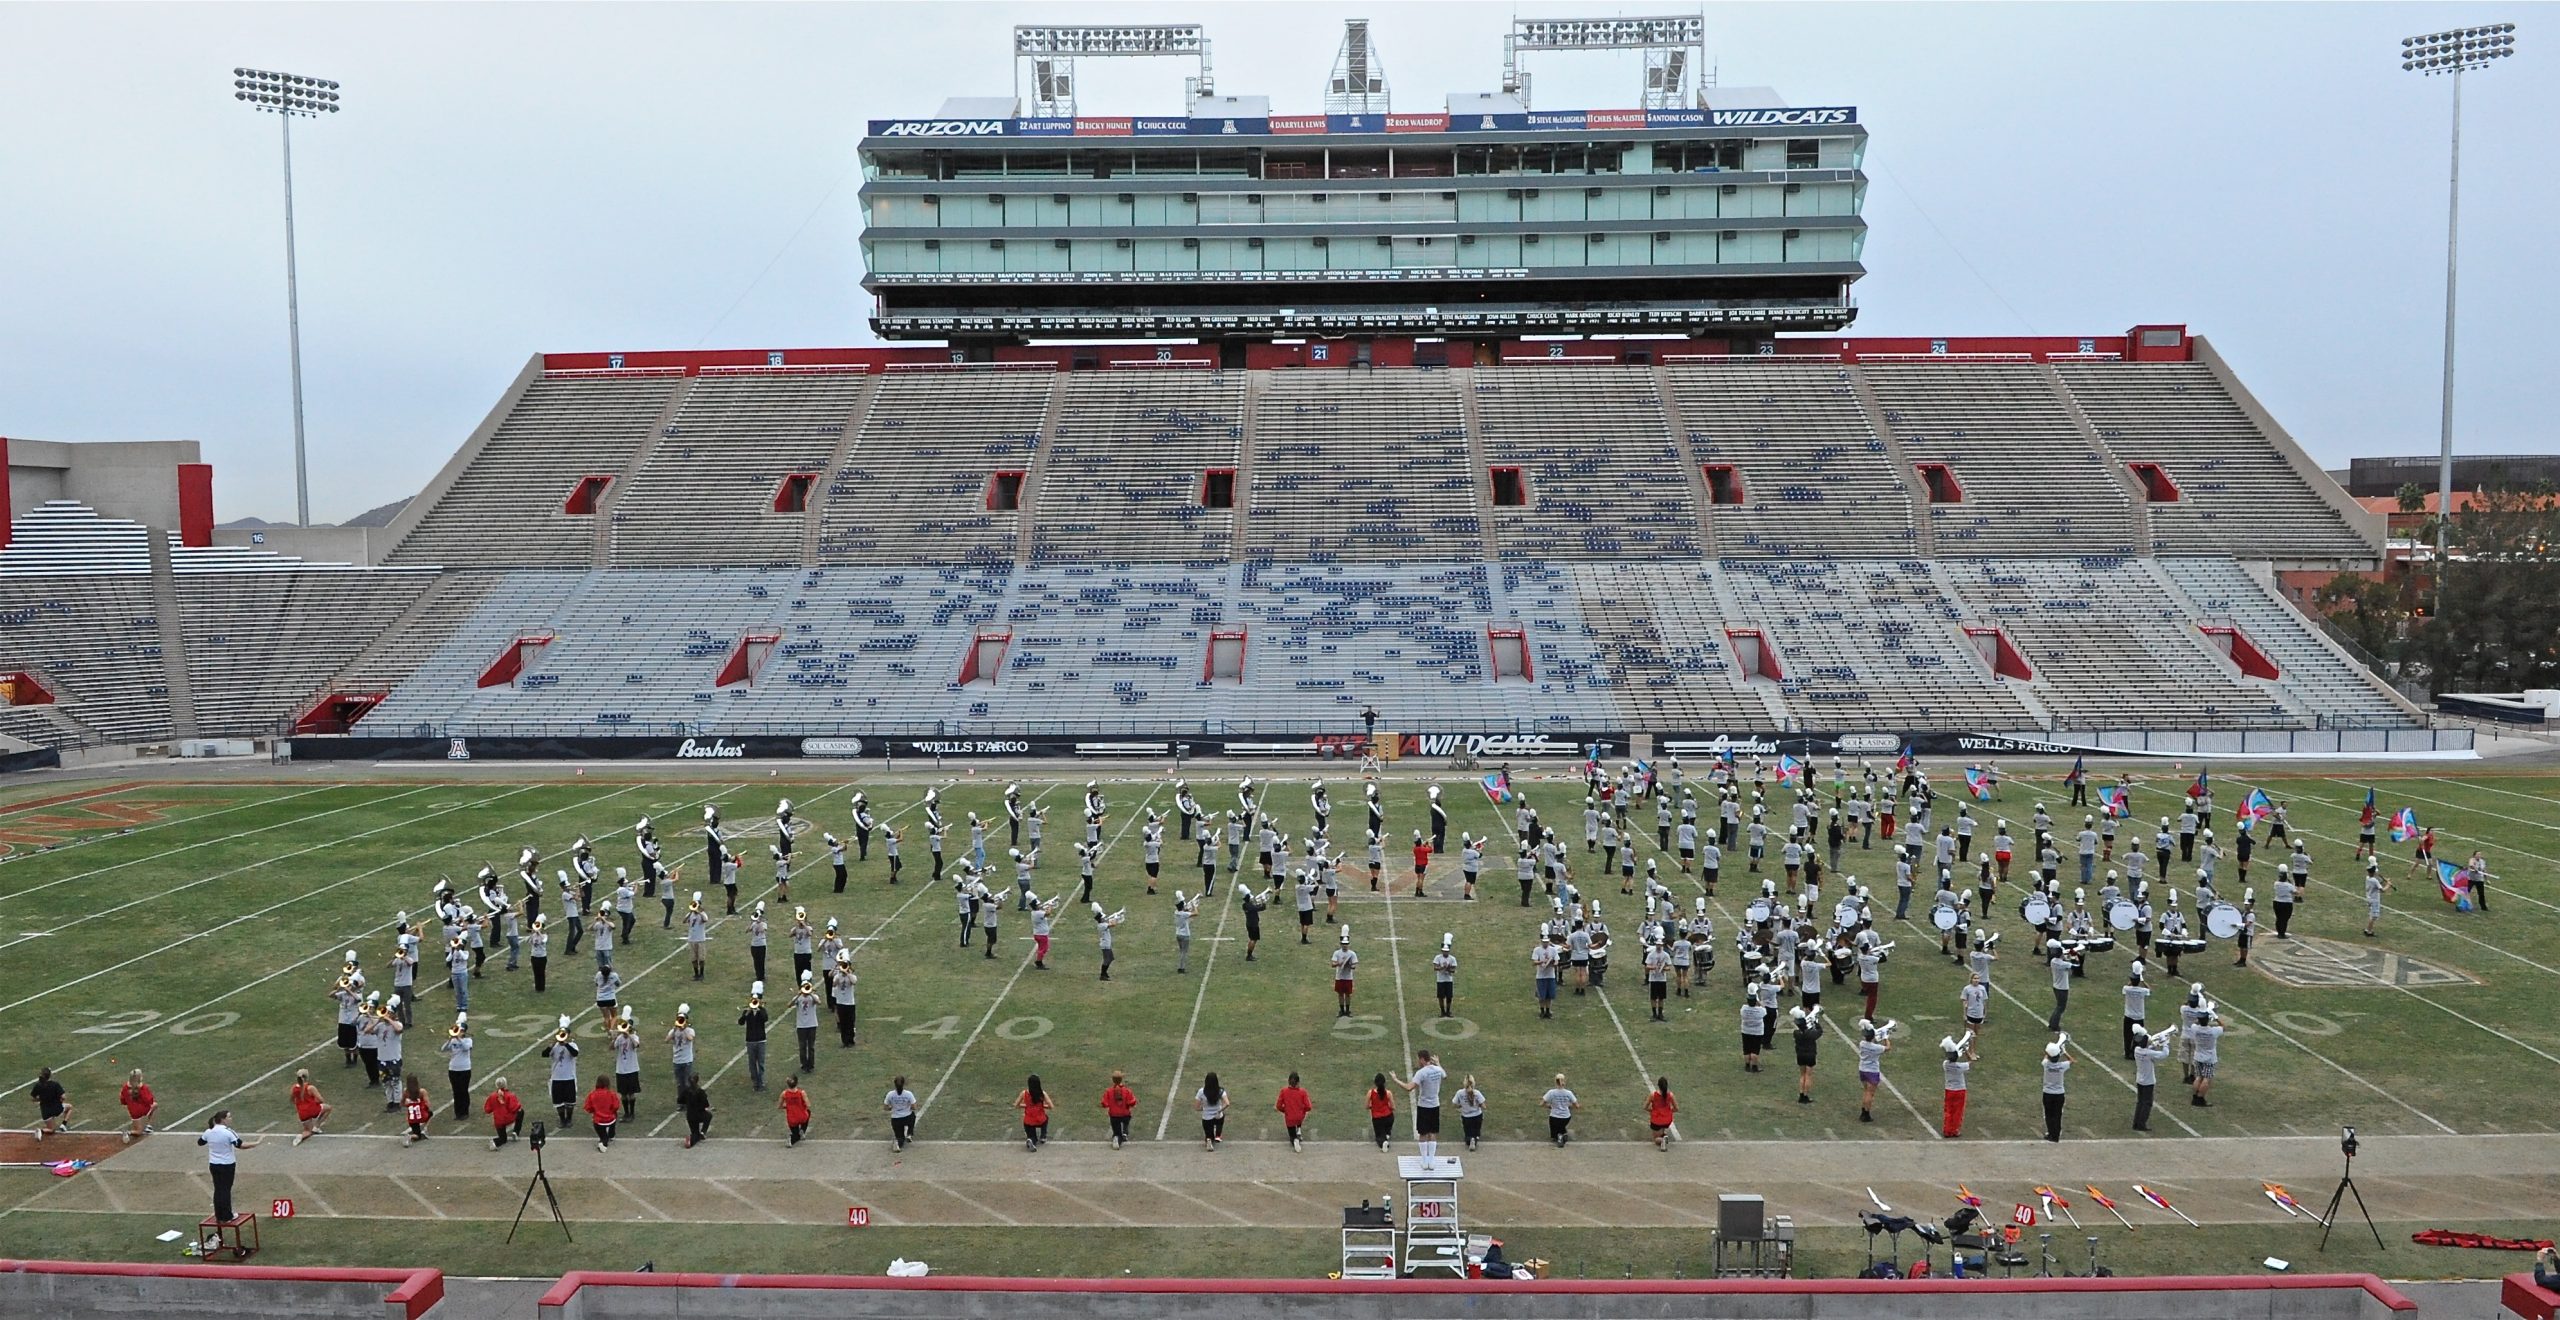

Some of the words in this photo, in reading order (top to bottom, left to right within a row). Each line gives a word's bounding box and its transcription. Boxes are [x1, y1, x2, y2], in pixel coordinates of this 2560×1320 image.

[1537, 116, 1552, 124] STEVE
[1613, 114, 1645, 122] McALISTER
[1713, 110, 1849, 124] WILDCATS
[1020, 121, 1028, 130] 22
[1028, 122, 1041, 130] ART
[1042, 122, 1071, 130] LUPPINO
[1085, 122, 1104, 130] RICKY
[1106, 122, 1131, 130] HUNLEY
[1143, 121, 1167, 129] CHUCK
[1275, 121, 1304, 129] DARRYLL
[1410, 118, 1443, 126] WALDROP
[882, 122, 1003, 136] ARIZONA
[1550, 347, 1563, 357] 22
[1760, 345, 1773, 355] 23
[1932, 345, 1945, 354] 24
[2080, 344, 2093, 353] 25
[952, 354, 963, 363] 19
[1157, 352, 1171, 360] 20
[1314, 350, 1326, 359] 21
[611, 359, 622, 368] 17
[770, 356, 782, 365] 18
[253, 534, 263, 542] 16
[677, 738, 745, 757] Bashas'
[920, 741, 972, 752] WELLS
[976, 741, 1028, 752] FARGO
[1312, 735, 1420, 757] ARIZA
[1419, 734, 1549, 756] WILDCATS
[1958, 738, 2014, 750] WELLS
[2018, 740, 2072, 753] FARGO
[902, 1016, 1056, 1042] 40
[1330, 1016, 1480, 1042] 50
[273, 1200, 290, 1217] 30
[1422, 1202, 1439, 1217] 50
[850, 1209, 866, 1224] 40
[2015, 1206, 2032, 1223] 40
